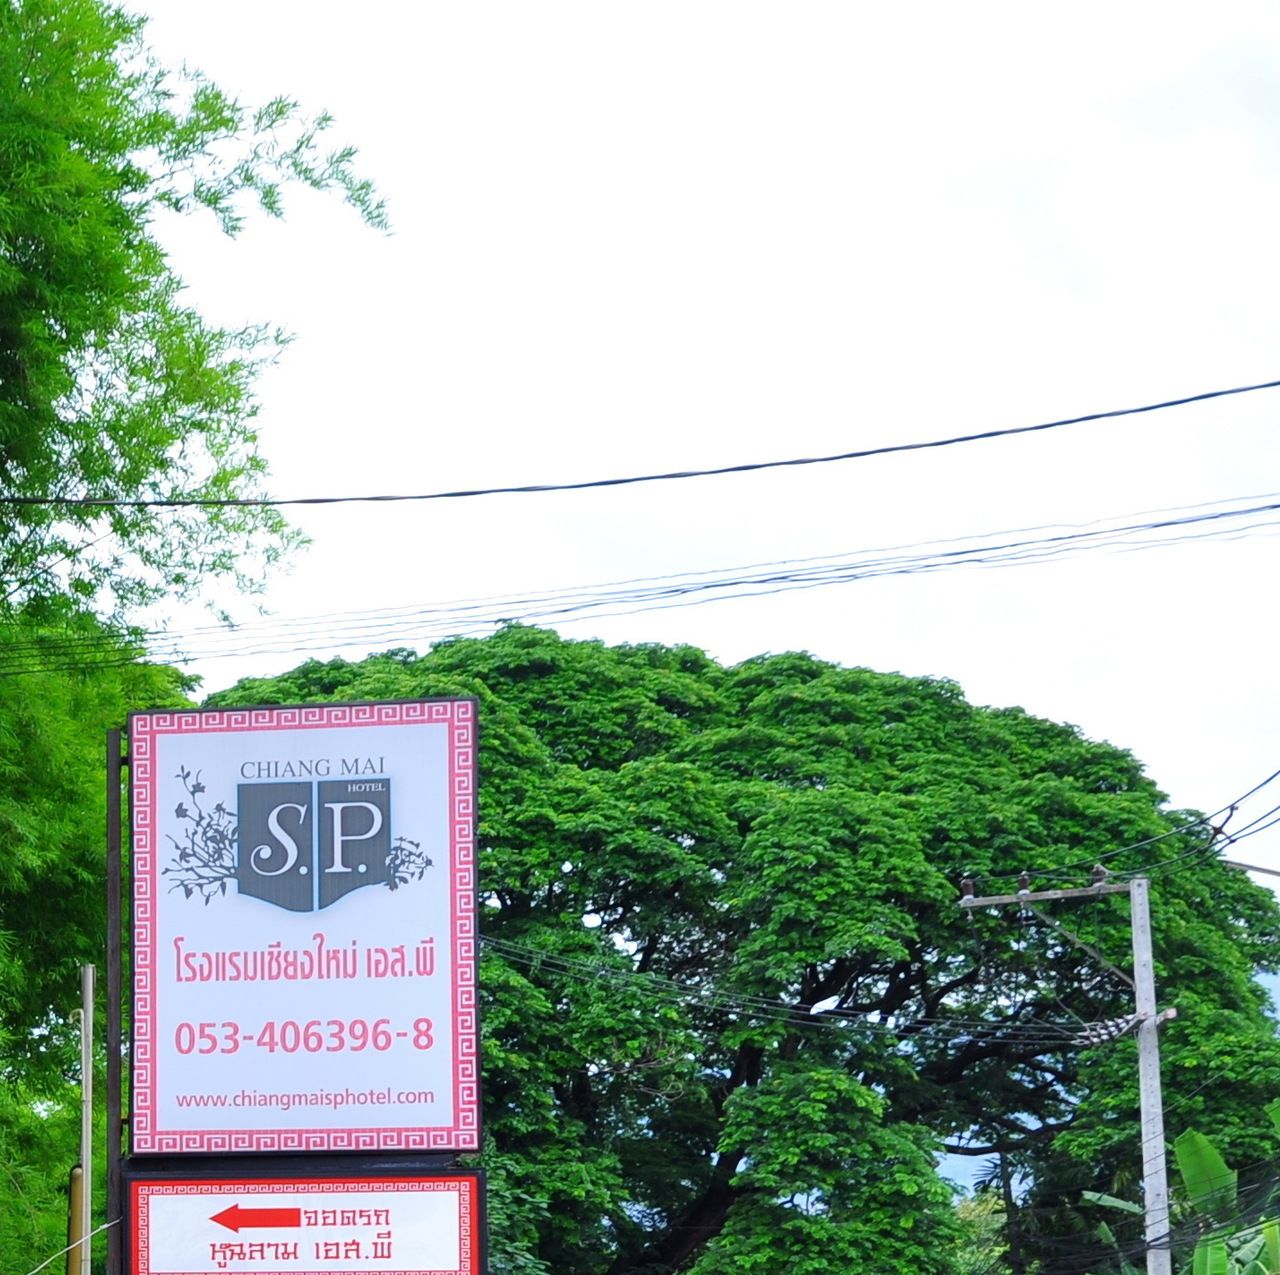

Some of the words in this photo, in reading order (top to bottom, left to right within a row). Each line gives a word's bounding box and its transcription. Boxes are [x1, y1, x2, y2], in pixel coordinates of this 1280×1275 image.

[240, 758, 331, 779] CHIANG
[341, 756, 385, 775] MAI
[347, 783, 386, 793] HOTEL
[173, 932, 357, 983] โรงแรมเชียงใหม่
[366, 937, 435, 978] เอส.พี
[174, 1017, 435, 1055] 053-406396-8
[176, 1088, 435, 1111] www.chiangmaisphotel.com
[303, 1208, 391, 1227] จอดรถ
[315, 1230, 392, 1260] เอส.พี
